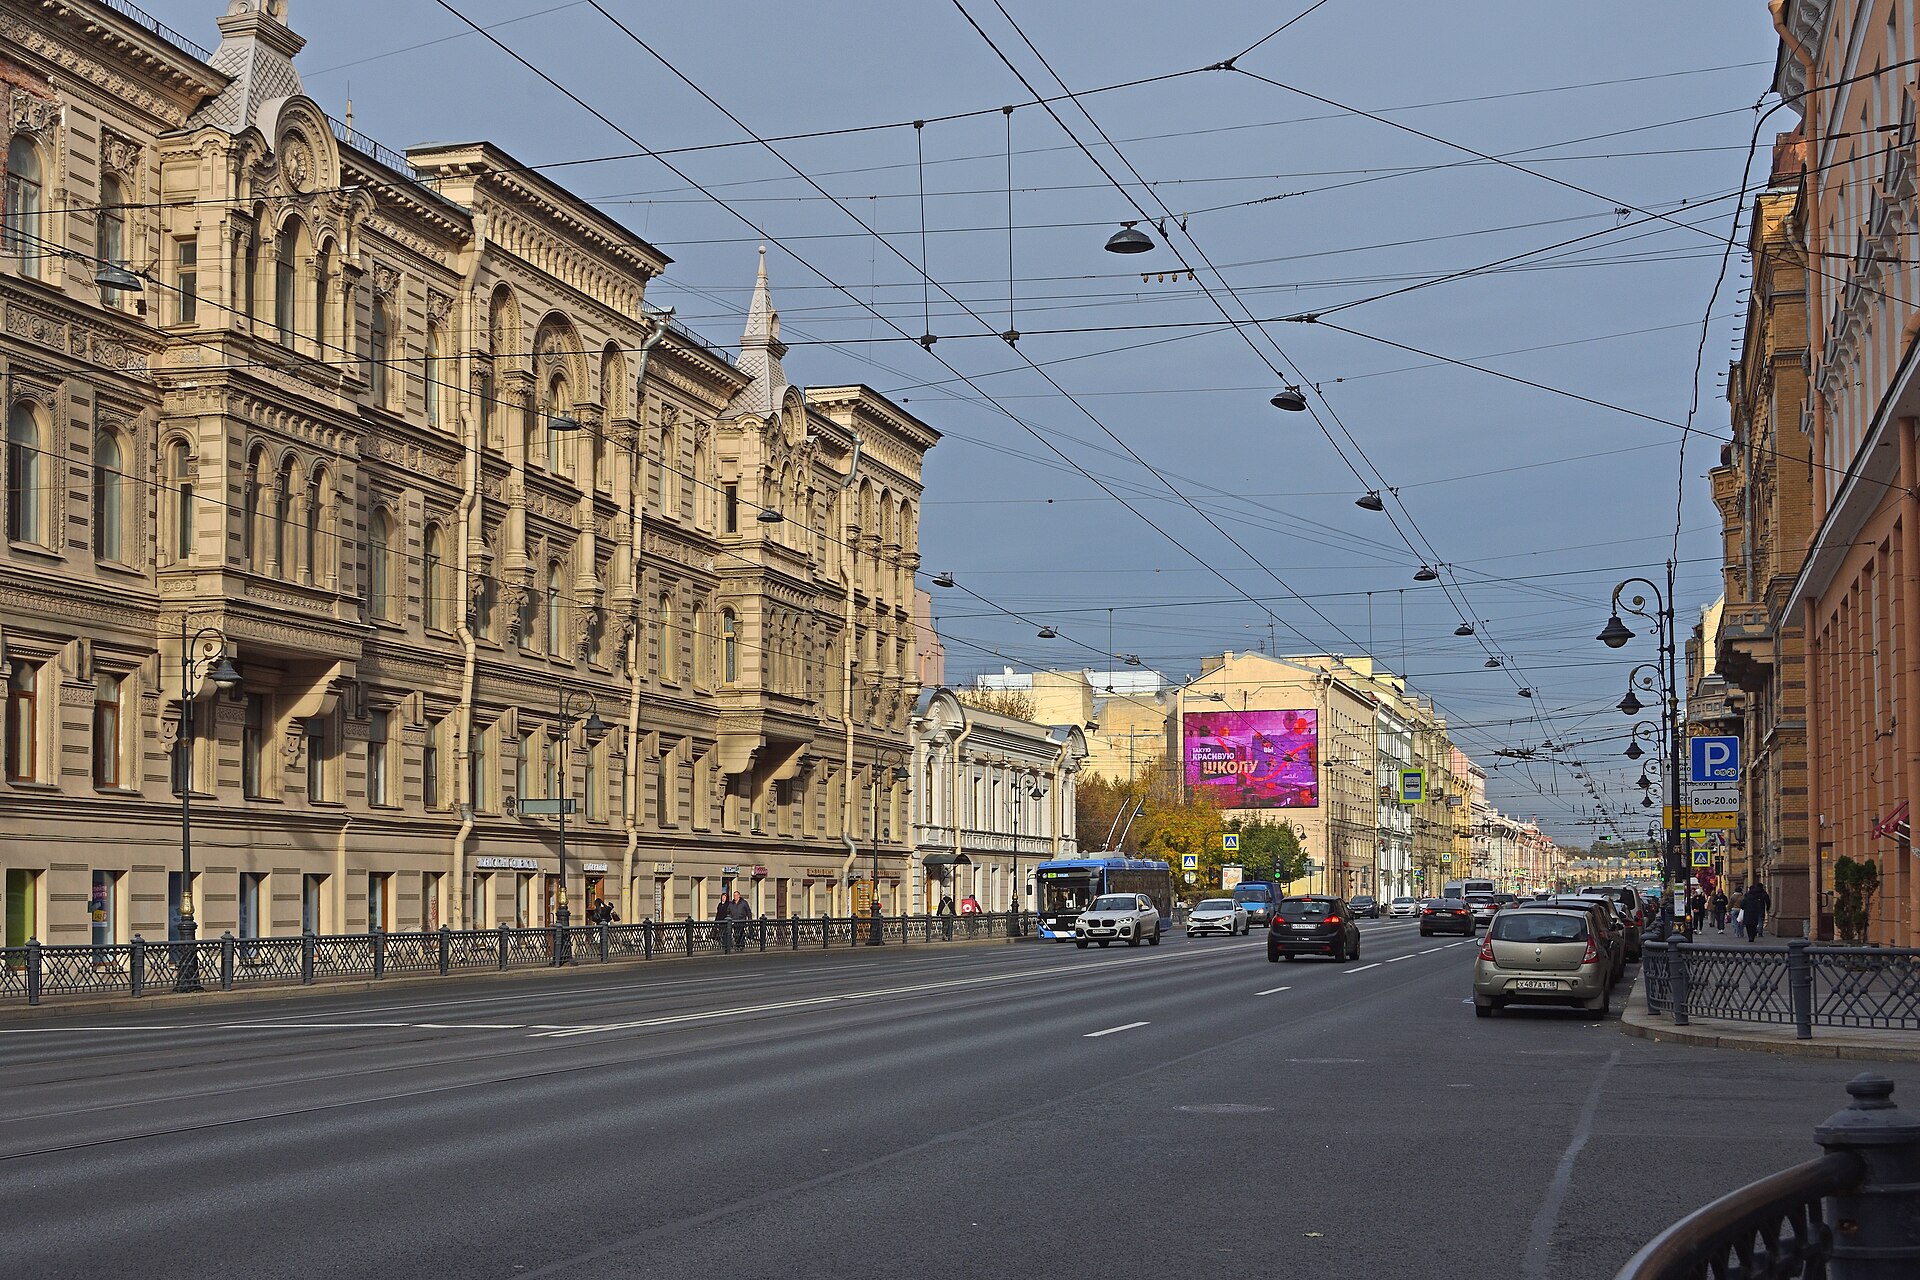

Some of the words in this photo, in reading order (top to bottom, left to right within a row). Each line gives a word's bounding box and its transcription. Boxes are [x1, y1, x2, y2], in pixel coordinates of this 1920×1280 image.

[1192, 752, 1235, 760] КРАСИВУЮ
[1704, 742, 1730, 777] P
[1203, 760, 1259, 775] ШКОЛУ
[1694, 796, 1738, 806] 8.00-20.00
